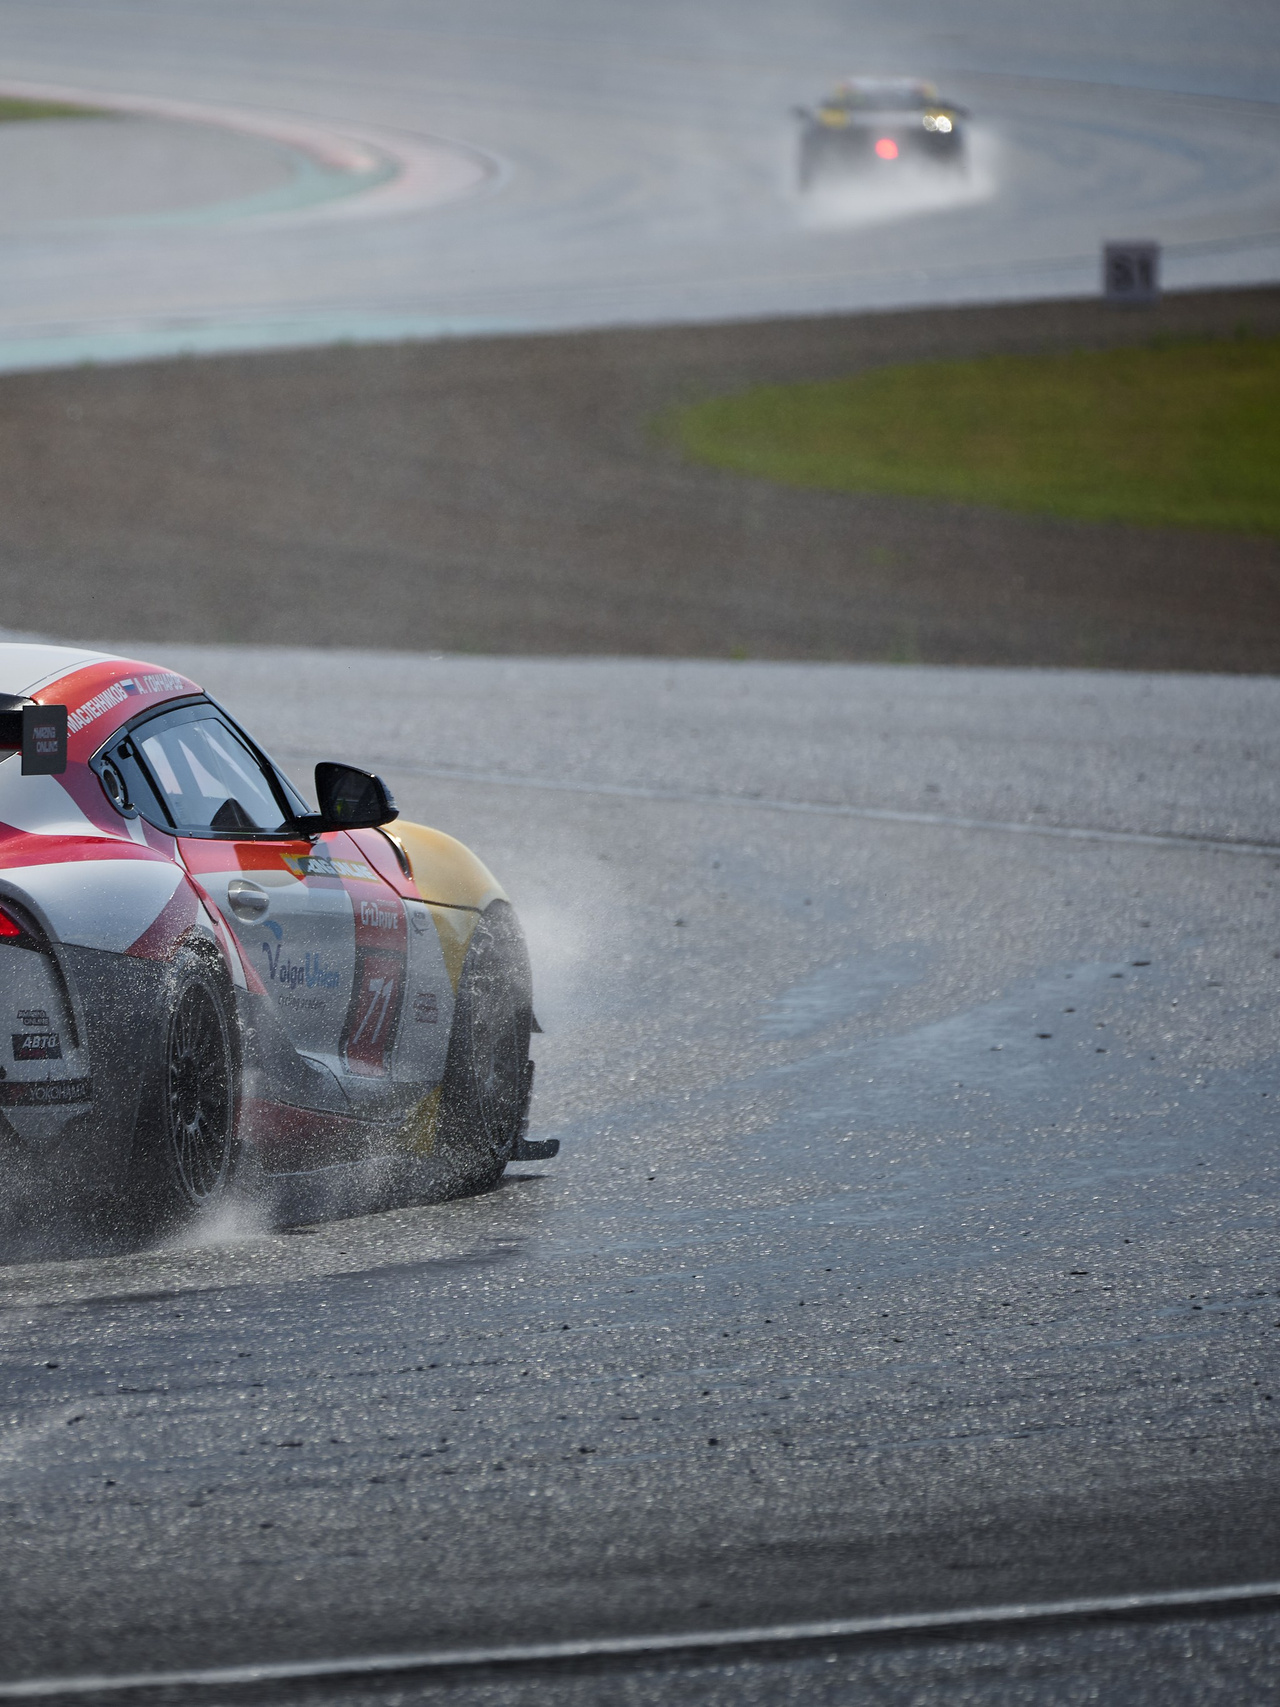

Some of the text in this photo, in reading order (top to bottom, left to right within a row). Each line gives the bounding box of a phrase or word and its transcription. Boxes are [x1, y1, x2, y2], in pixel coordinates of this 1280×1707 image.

[67, 682, 128, 734] МАСЛЕННИКОВ
[133, 677, 147, 695] А.
[353, 977, 394, 1044] 71
[30, 1084, 86, 1100] YOKOHAMA
